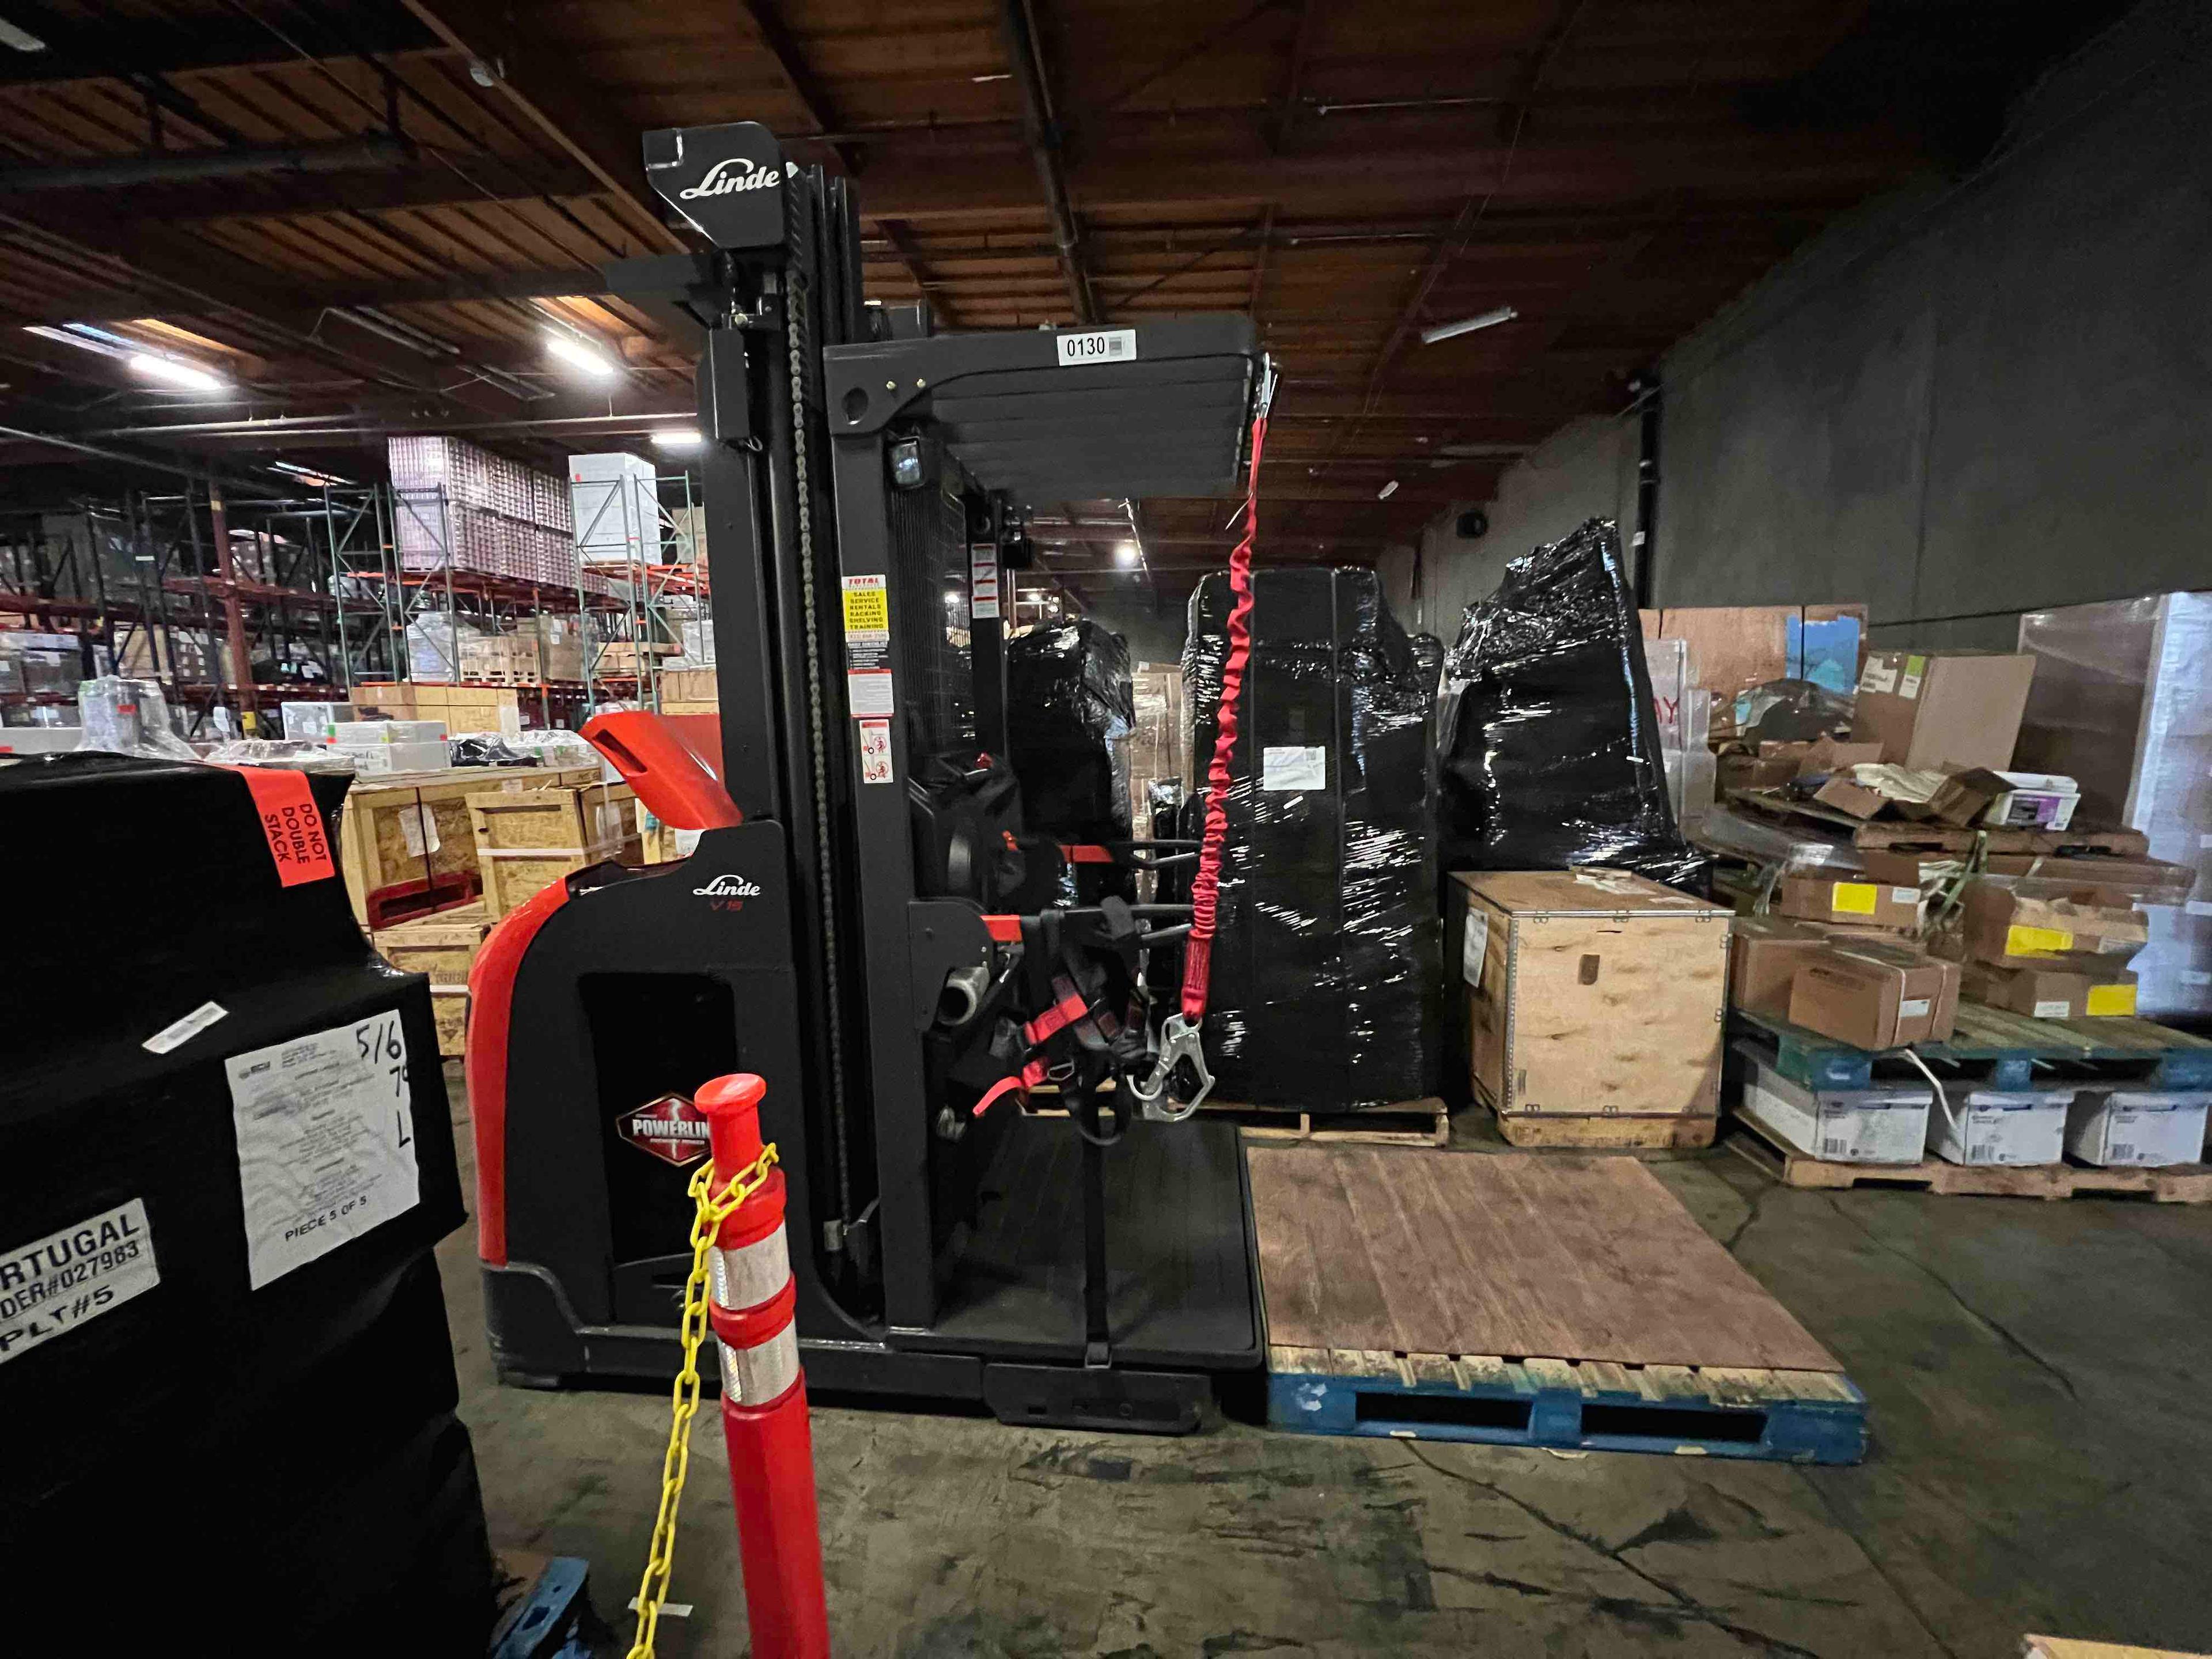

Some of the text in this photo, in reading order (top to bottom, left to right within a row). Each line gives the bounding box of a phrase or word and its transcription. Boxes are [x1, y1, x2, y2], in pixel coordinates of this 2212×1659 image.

[679, 158, 780, 199] Linde
[1067, 336, 1105, 357] 0130
[264, 813, 292, 862] STACK
[281, 807, 310, 864] DOUBLE
[300, 804, 327, 861] DO NOT
[692, 874, 760, 896] Linde
[356, 1021, 402, 1065] 5/6
[285, 1215, 327, 1242] PIECE
[329, 1209, 337, 1221] 5
[340, 1200, 356, 1215] OF
[359, 1195, 367, 1206] 5
[0, 1214, 139, 1290] RTUGAL
[0, 1285, 113, 1351] PLT#5
